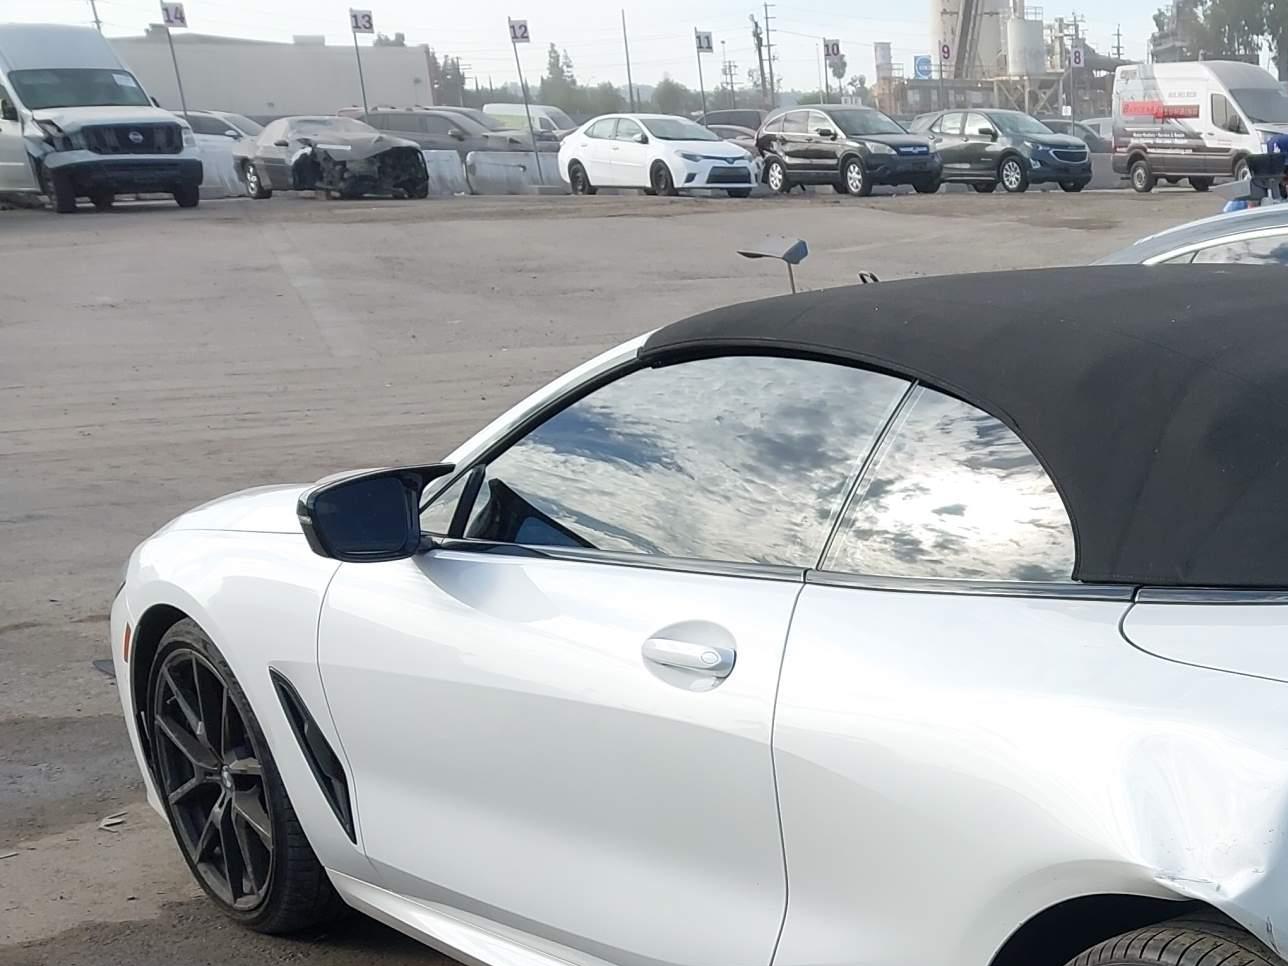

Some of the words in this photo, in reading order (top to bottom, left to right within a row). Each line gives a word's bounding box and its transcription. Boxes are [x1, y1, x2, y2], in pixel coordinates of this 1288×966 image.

[162, 6, 184, 24] 14
[351, 14, 373, 30] 13
[510, 24, 528, 39] 12
[696, 35, 712, 49] 11
[825, 43, 840, 56] 10
[942, 44, 950, 60] 9
[1074, 50, 1081, 65] 8
